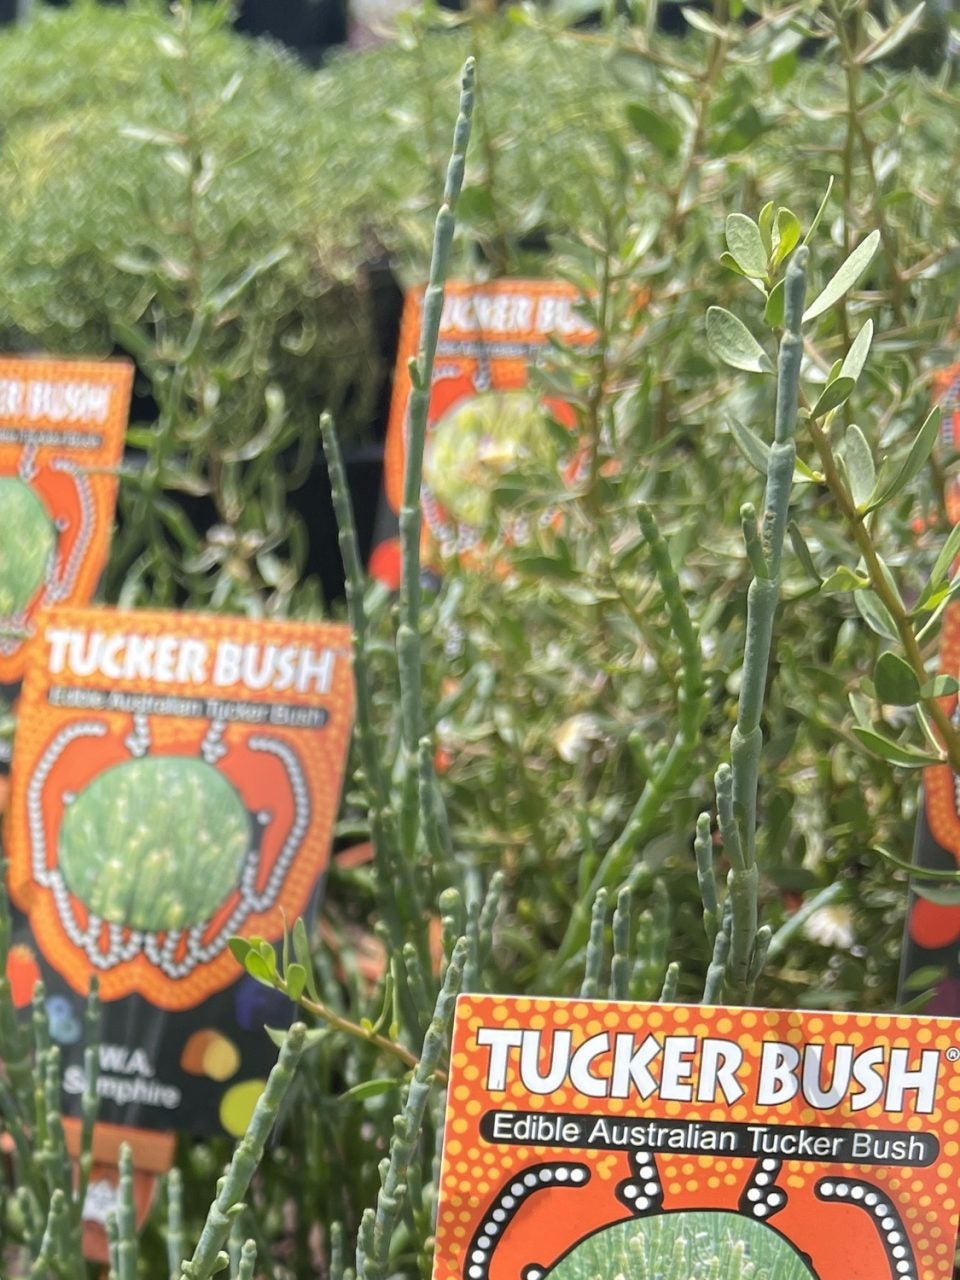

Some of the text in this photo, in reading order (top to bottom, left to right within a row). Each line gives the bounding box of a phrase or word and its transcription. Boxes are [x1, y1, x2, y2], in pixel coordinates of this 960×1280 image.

[420, 294, 532, 334] UCKER
[44, 627, 336, 695] TUCKER BUSH
[63, 1064, 181, 1109] Smphire
[476, 1026, 745, 1107] TUCKER
[492, 1113, 925, 1161] Edible Australian Tucker Bush
